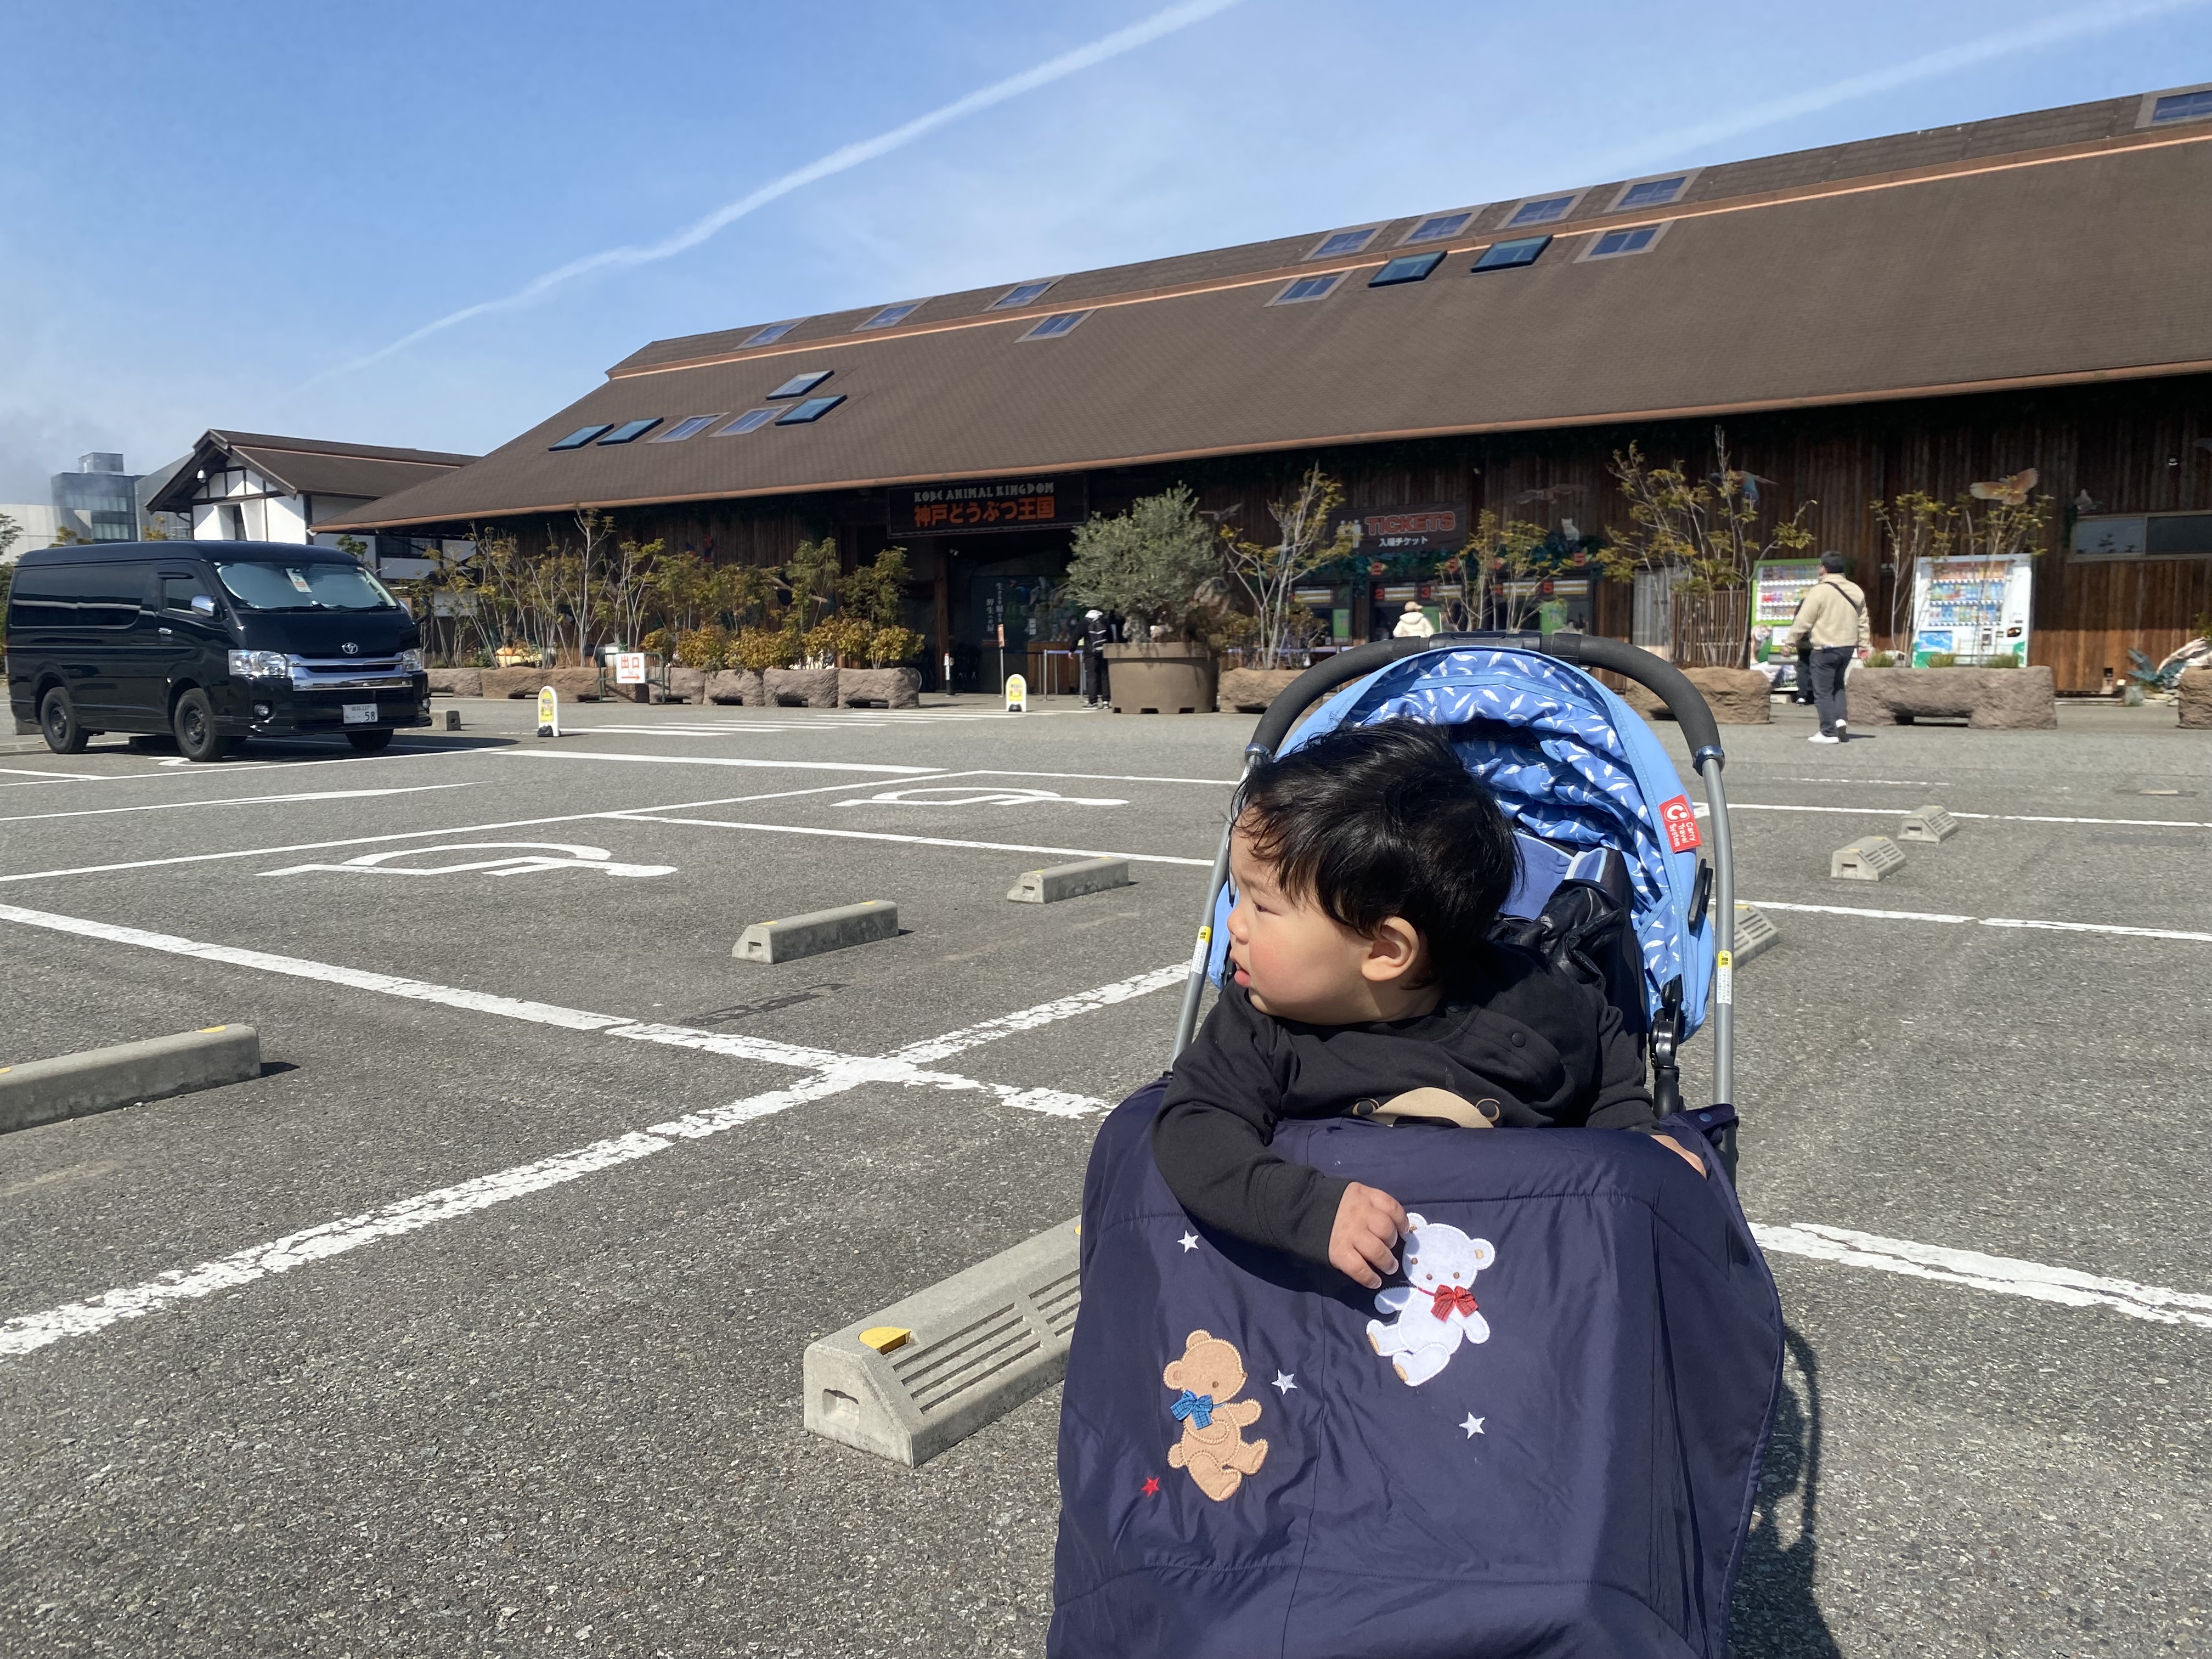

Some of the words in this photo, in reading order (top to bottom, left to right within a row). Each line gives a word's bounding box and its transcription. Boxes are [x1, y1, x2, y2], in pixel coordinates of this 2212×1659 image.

[914, 489, 943, 503] KOBE
[945, 486, 994, 500] ANIMAL
[996, 482, 1054, 496] KINGDOM
[914, 495, 1055, 527] 神戸どうぶつ王国
[1364, 511, 1455, 536] TICKETS
[1375, 588, 1384, 600] 2
[1421, 586, 1430, 598] 3
[1543, 582, 1553, 594] 5
[621, 655, 640, 669] 出口
[1669, 823, 1680, 848] System
[1677, 822, 1690, 844] Travel
[1685, 821, 1696, 841] Carry
